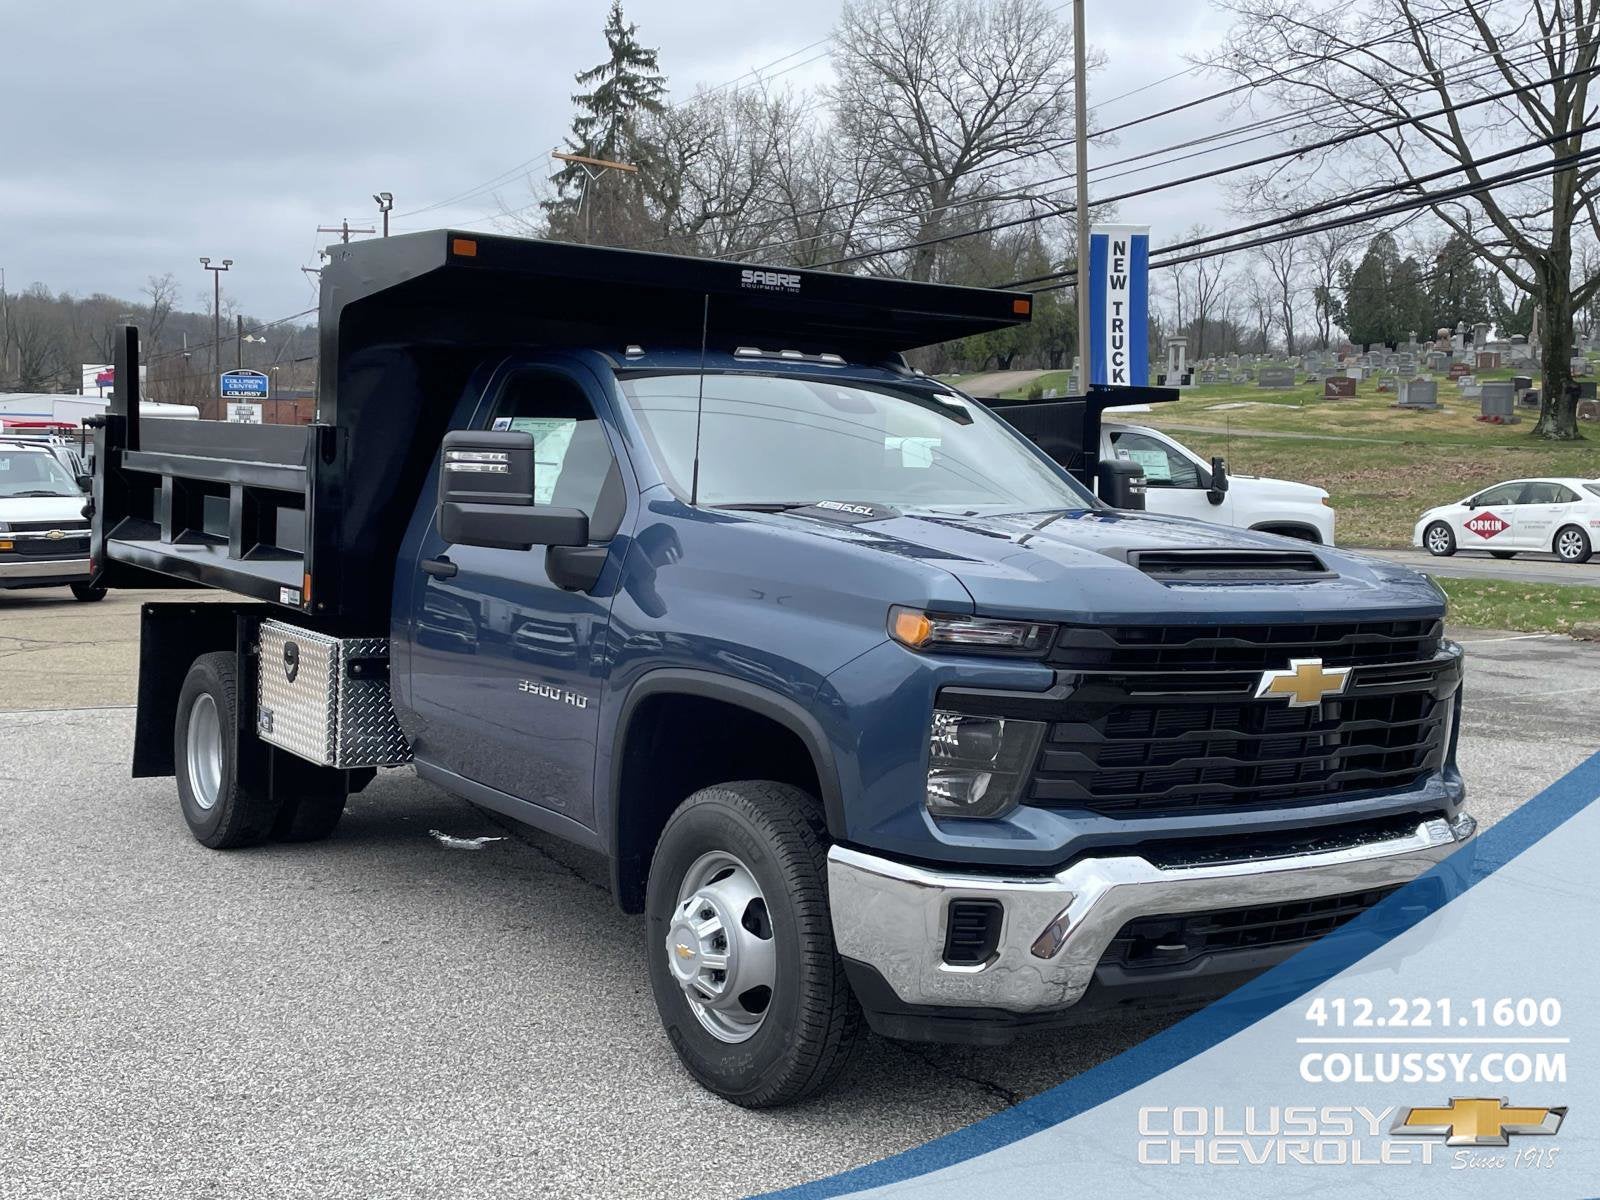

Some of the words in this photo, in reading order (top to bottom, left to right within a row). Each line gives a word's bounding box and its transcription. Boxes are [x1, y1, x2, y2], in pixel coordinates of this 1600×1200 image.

[1110, 241, 1127, 290] NEW
[741, 282, 784, 292] EQUIPMENT
[742, 270, 801, 288] SABRE
[1469, 520, 1503, 531] ORKIN
[518, 679, 561, 701] 3500
[565, 691, 588, 709] HD
